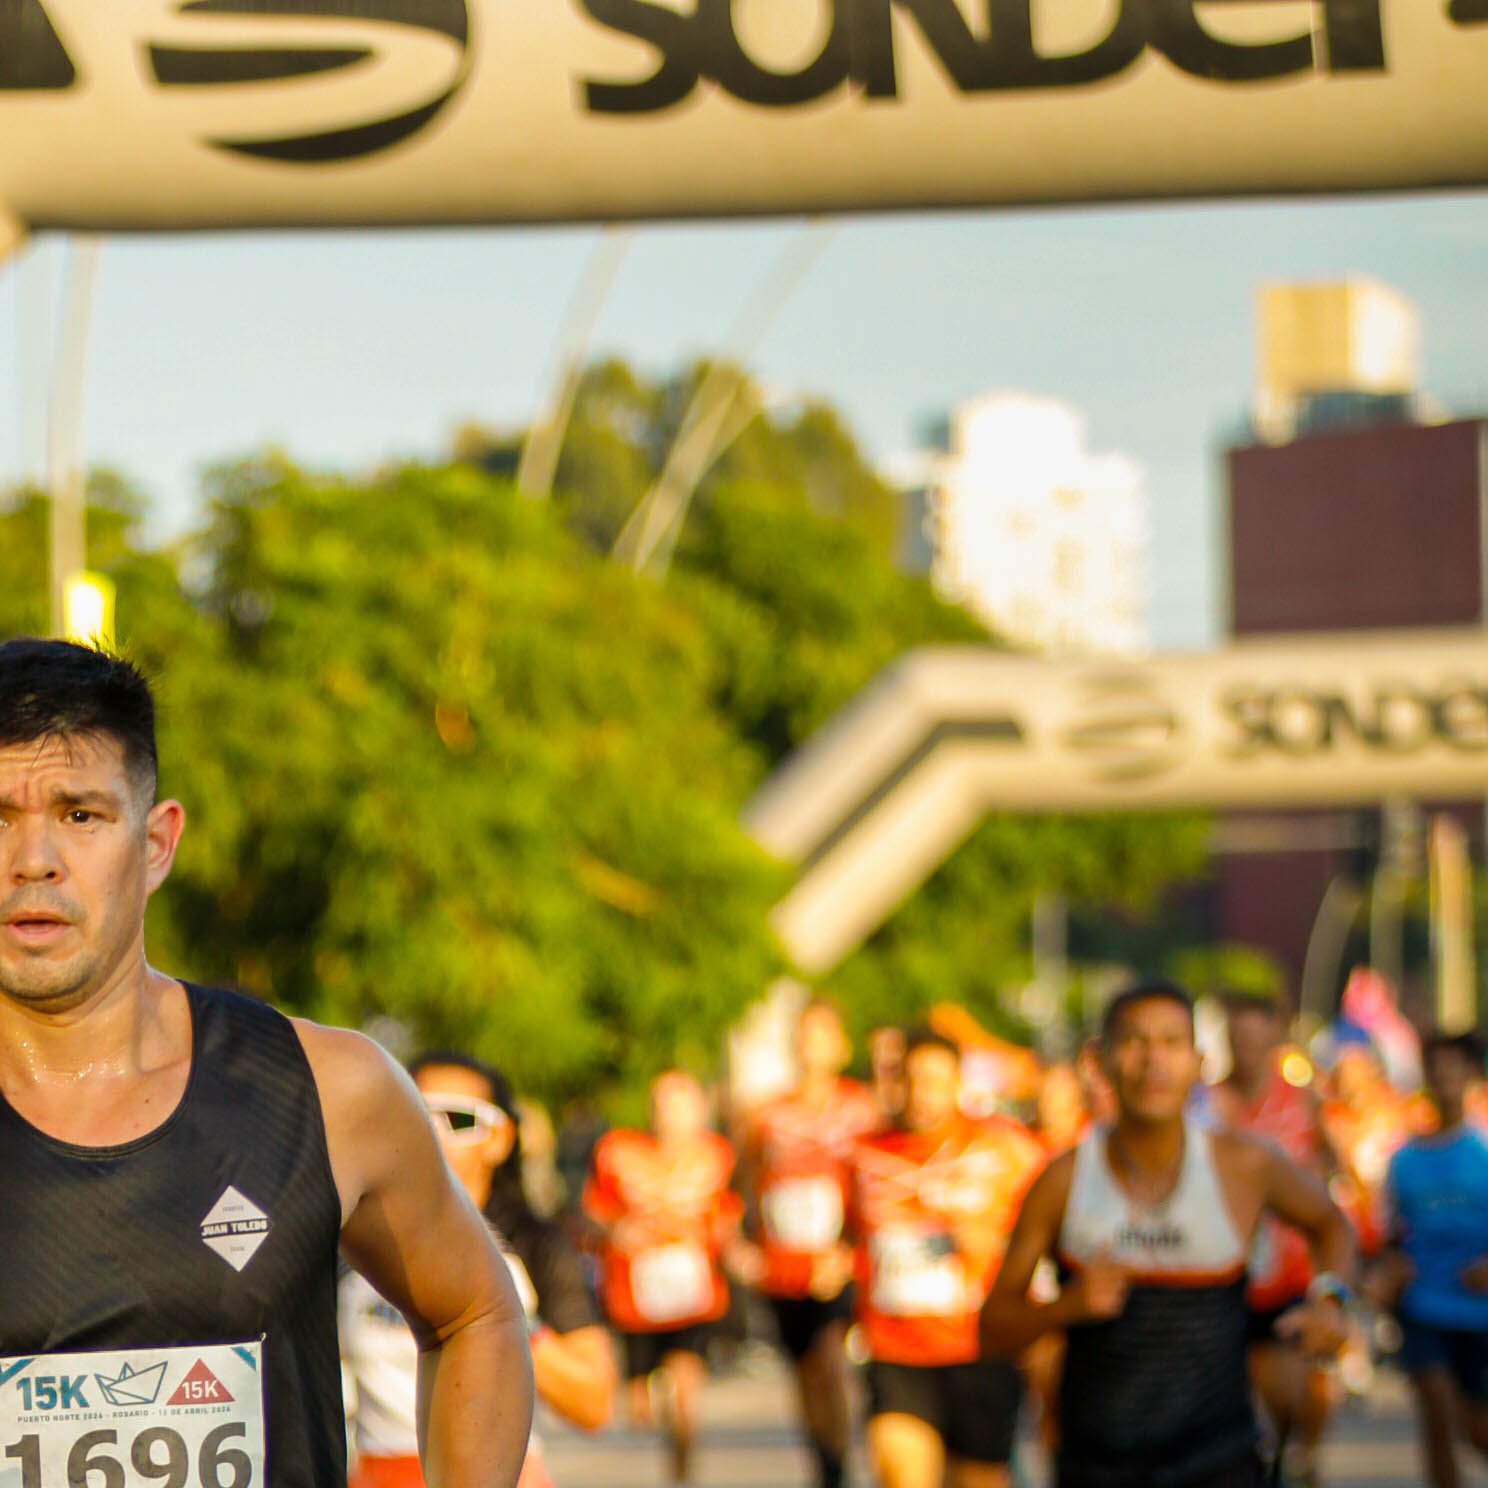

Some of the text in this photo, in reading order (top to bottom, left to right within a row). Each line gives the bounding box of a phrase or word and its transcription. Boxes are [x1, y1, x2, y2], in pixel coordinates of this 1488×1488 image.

[201, 1220, 268, 1237] JUAN TOLEDO
[16, 1374, 90, 1411] 15K
[181, 1379, 220, 1401] 15K
[17, 1415, 50, 1423] PUERTO
[53, 1413, 81, 1422] NORTE
[112, 1409, 149, 1418] ROSARIO
[170, 1407, 181, 1416] DE
[184, 1406, 209, 1415] ABRIL
